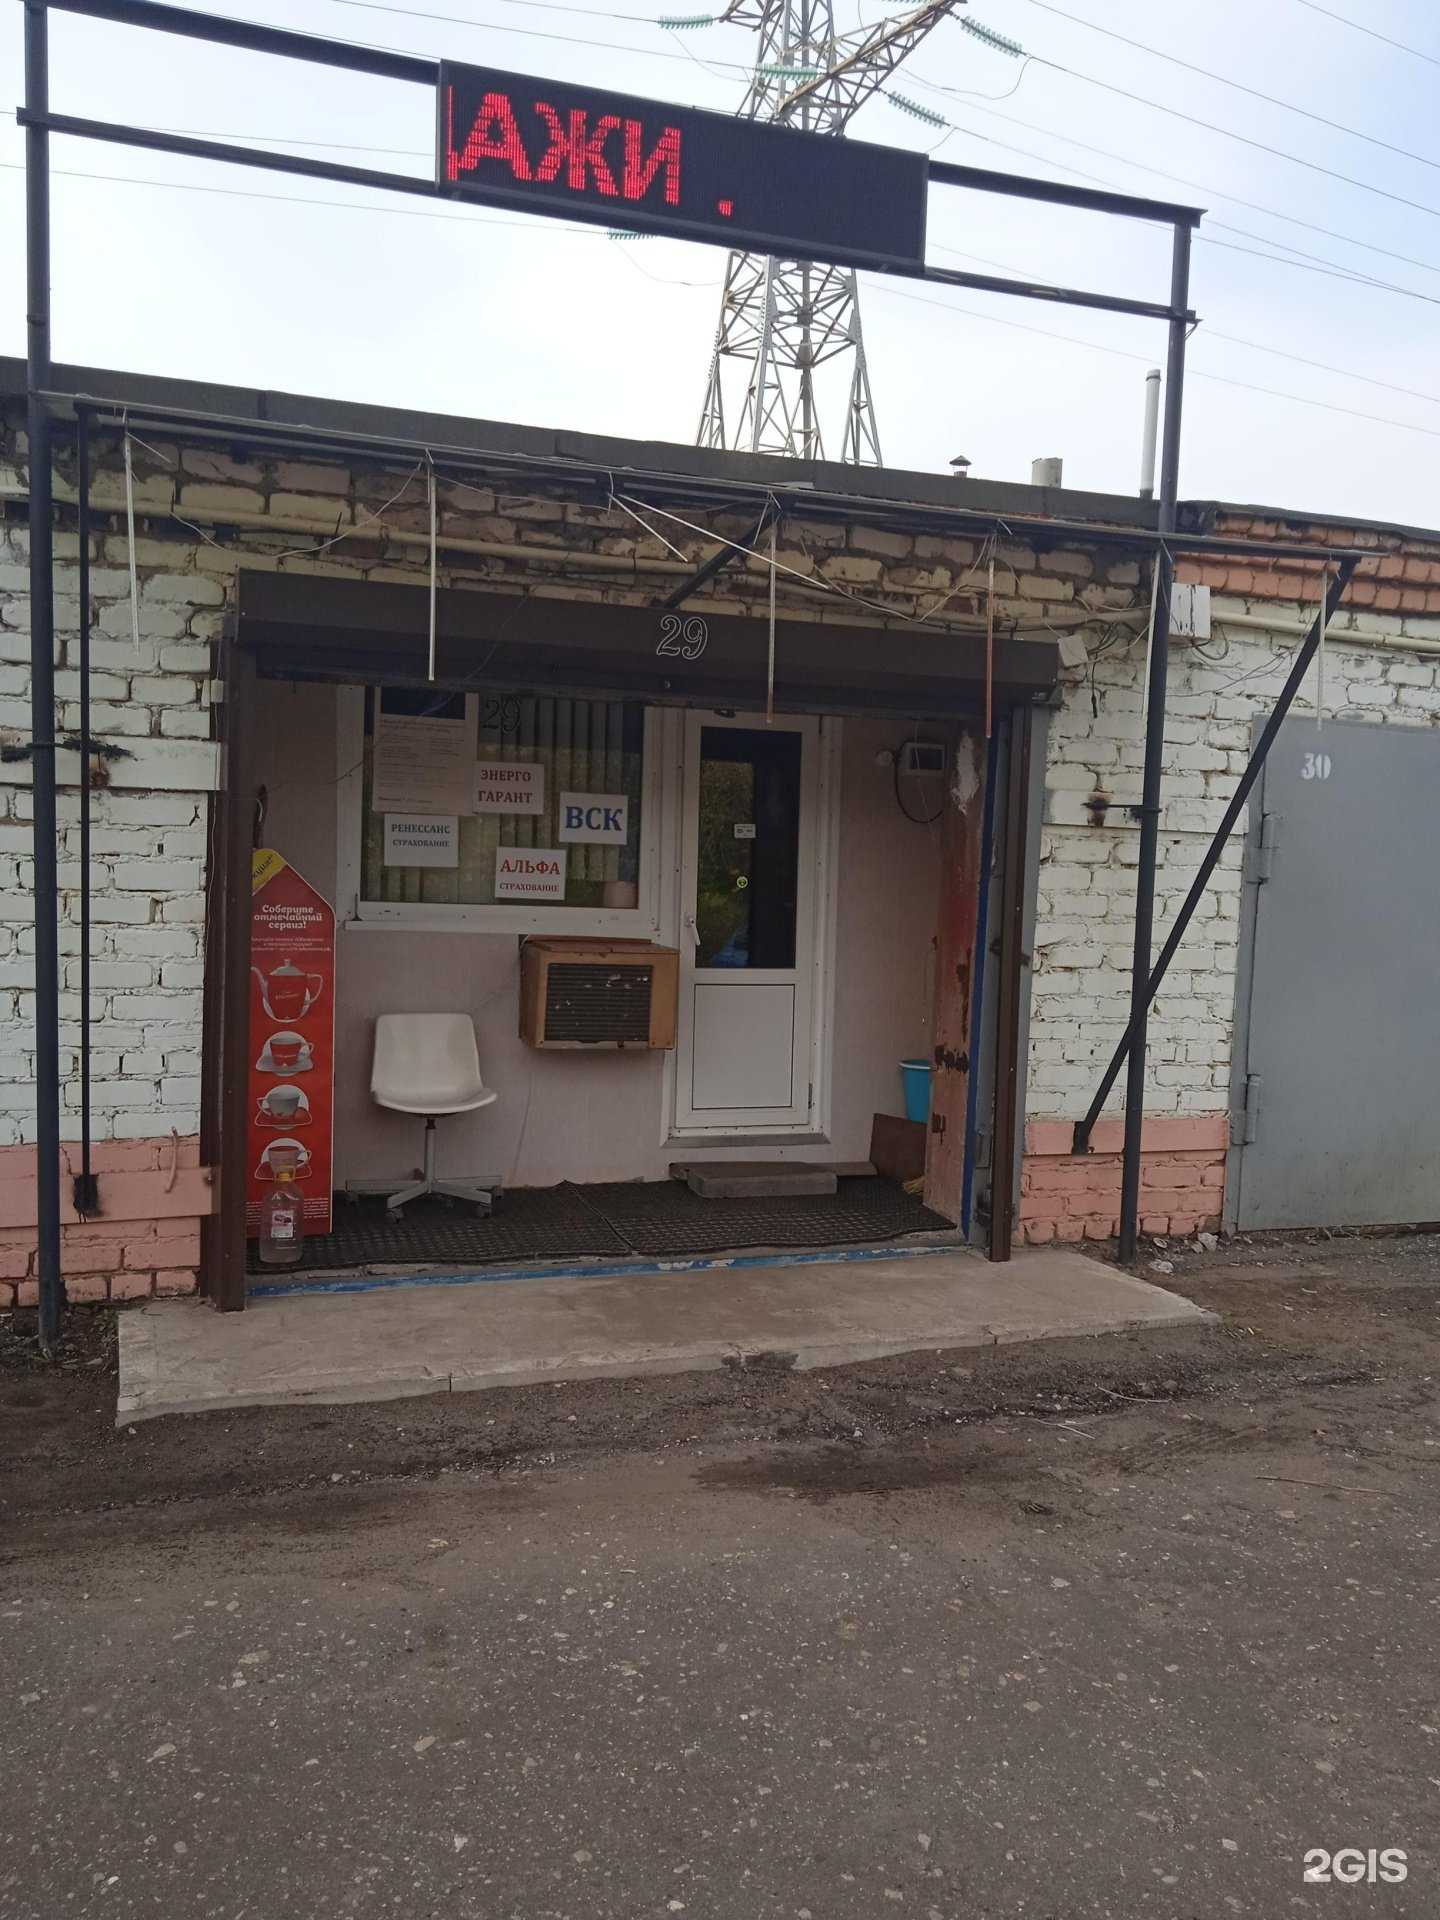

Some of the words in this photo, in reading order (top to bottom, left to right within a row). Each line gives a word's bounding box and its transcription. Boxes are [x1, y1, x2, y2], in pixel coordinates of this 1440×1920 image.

[656, 614, 708, 660] 29
[1300, 752, 1332, 780] 30
[479, 768, 532, 783] ЭНЕРГО
[477, 790, 533, 804] ГАРАНТ
[564, 805, 623, 831] ВСК
[391, 822, 450, 835] РЕНЕССАНС
[392, 838, 450, 848] СТРАХОВАНИЕ
[499, 858, 561, 875] АЛЬФА
[499, 881, 560, 893] СТРАХОВАНИЕ
[262, 904, 314, 915] Соберите
